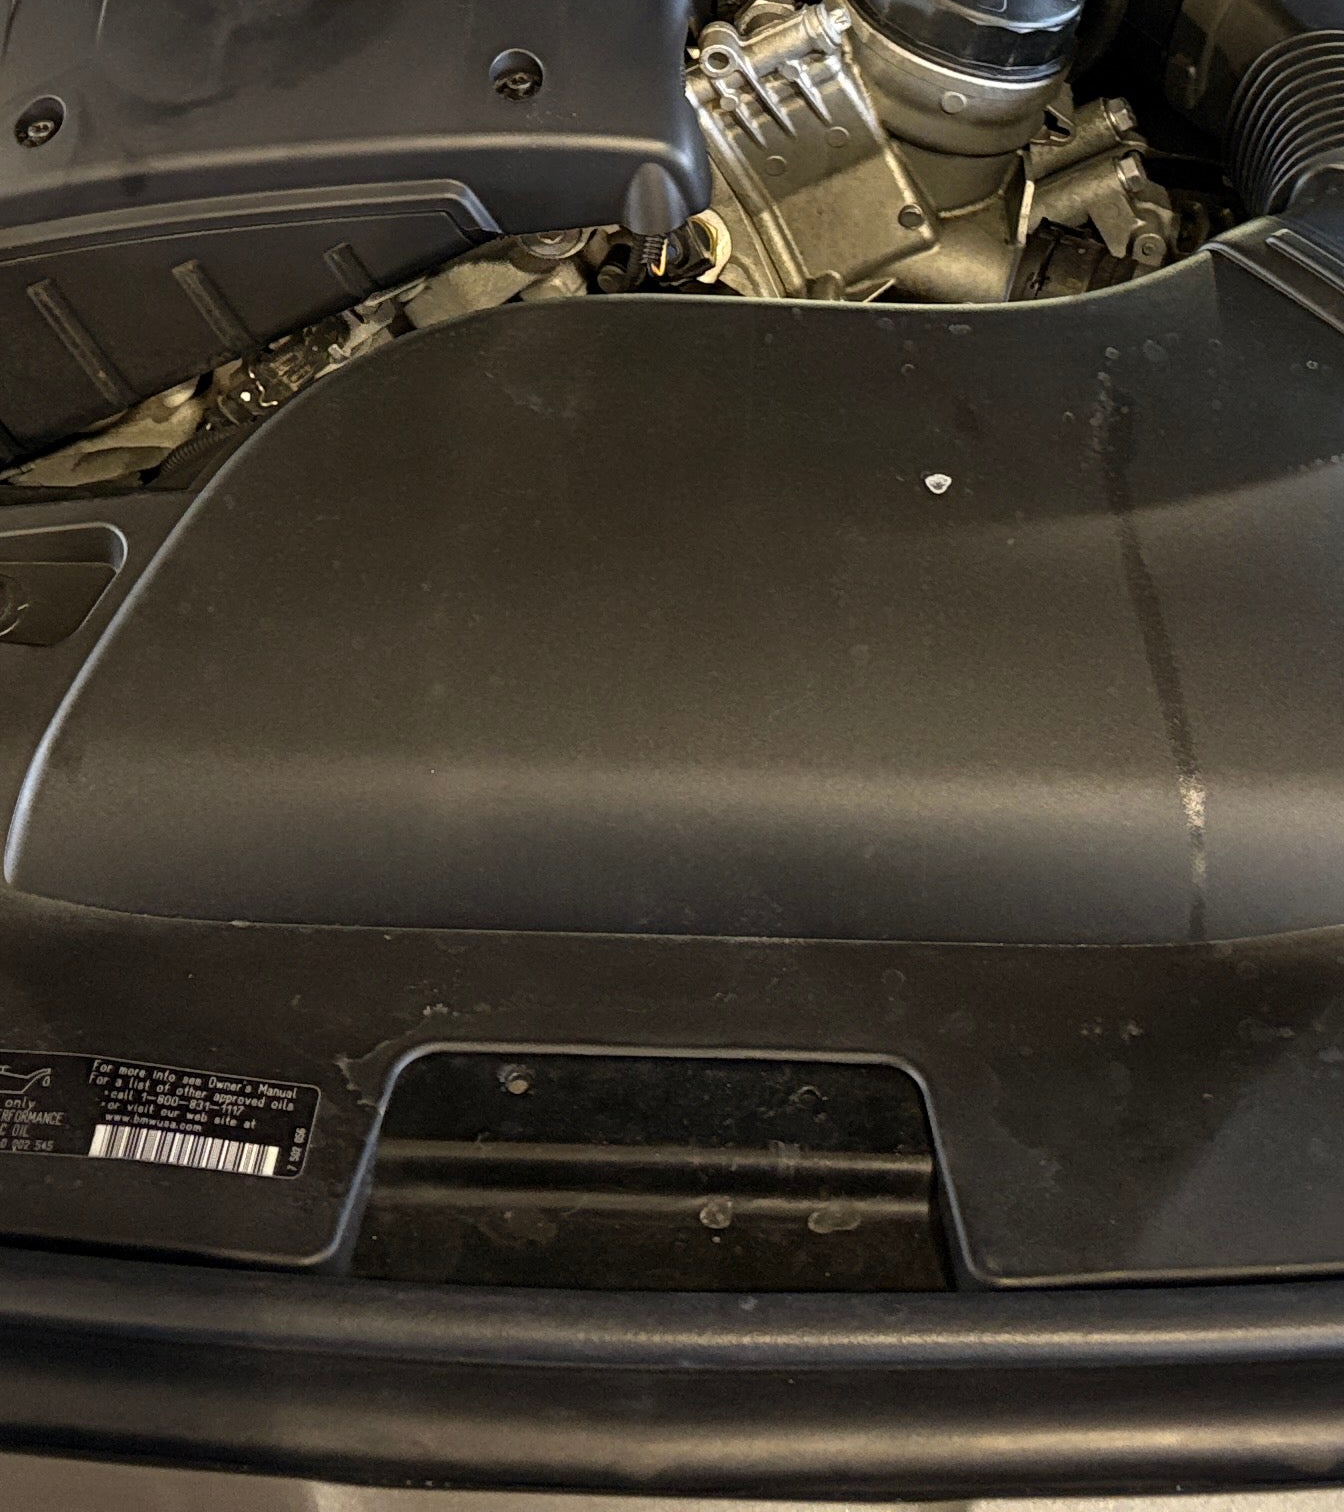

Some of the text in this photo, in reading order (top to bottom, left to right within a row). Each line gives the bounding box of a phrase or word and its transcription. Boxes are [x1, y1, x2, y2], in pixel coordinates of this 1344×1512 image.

[92, 1060, 113, 1074] For
[118, 1066, 146, 1078] more
[182, 1076, 202, 1086] see
[208, 1076, 252, 1094] Owner's
[258, 1084, 297, 1099] Manual
[6, 1096, 37, 1110] only
[88, 1072, 294, 1112] For a list of other approved oils
[141, 1092, 246, 1116] 1-800-831-1117
[106, 1112, 202, 1132] www.bmwusa.com
[127, 1102, 154, 1114] visit
[160, 1108, 180, 1118] our
[186, 1110, 208, 1123] web
[214, 1115, 237, 1128] site
[244, 1118, 256, 1130] at
[12, 1124, 29, 1137] OIL
